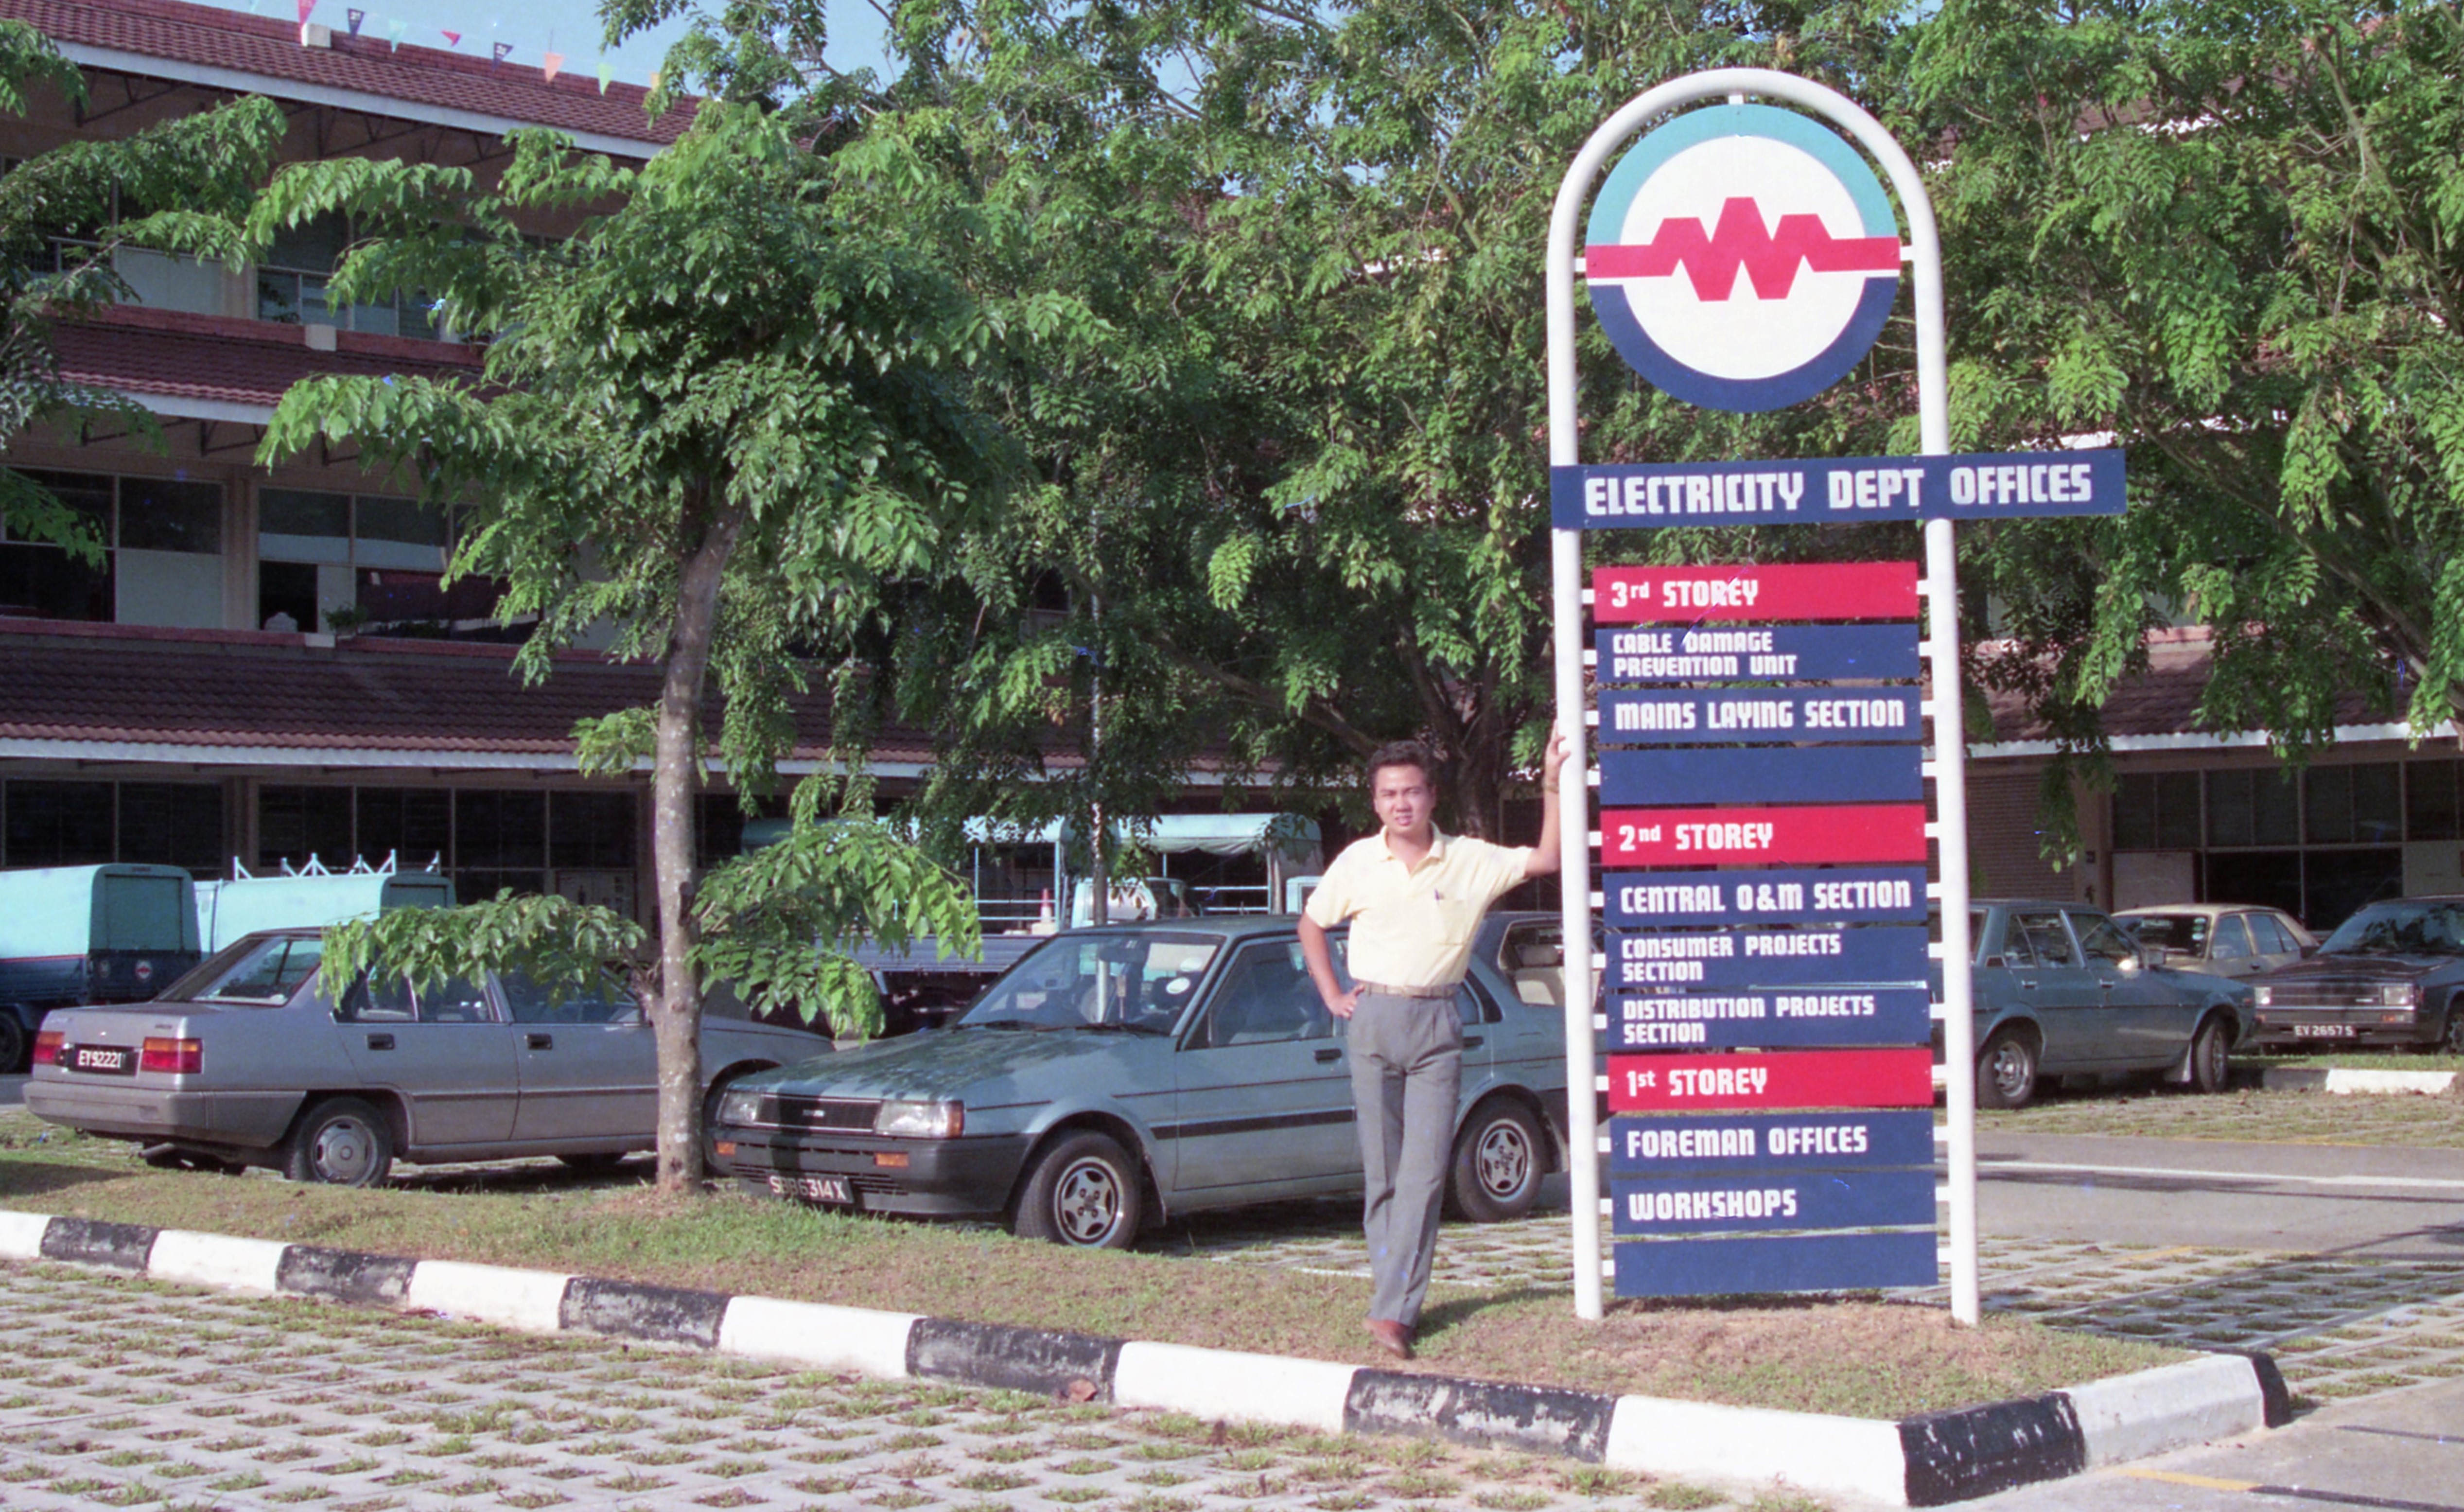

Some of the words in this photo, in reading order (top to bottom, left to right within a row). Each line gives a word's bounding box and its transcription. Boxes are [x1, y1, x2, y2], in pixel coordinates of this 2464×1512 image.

[1584, 471, 1804, 516] ELECTRICITY
[1828, 468, 1925, 510] DEPT
[1950, 463, 2092, 505] OFFICES
[1611, 580, 1650, 608] 3rd
[1662, 580, 1759, 608] STOREY
[1612, 633, 1673, 655] CABLE
[1685, 632, 1773, 654] DAMAGE
[1613, 655, 1738, 678] PREVENTION
[1749, 654, 1798, 676] UNIT
[1614, 701, 1696, 731] MAINS
[1707, 700, 1794, 730] LAYING
[1804, 699, 1905, 728] SECTION
[1618, 824, 1661, 852] 2nd
[1675, 822, 1773, 851] STOREY
[1620, 884, 1726, 914] CENTRAL
[1736, 882, 1803, 912] O&M
[1813, 879, 1911, 910] SECTION
[1621, 935, 1734, 960] CONSUMER
[1744, 933, 1841, 957] PROJECTS
[1622, 960, 1704, 983] SECTION
[1622, 996, 1766, 1020] DISTRIBUTION
[1775, 994, 1875, 1018] PROJECTS
[1623, 1021, 1706, 1045] SECTION
[1626, 1070, 1656, 1097] 1st
[1668, 1067, 1767, 1096] STOREY
[1626, 1128, 1756, 1159] FOREMAN
[1767, 1125, 1868, 1155] OFFICES
[1628, 1188, 1797, 1222] WORKSHOPS
